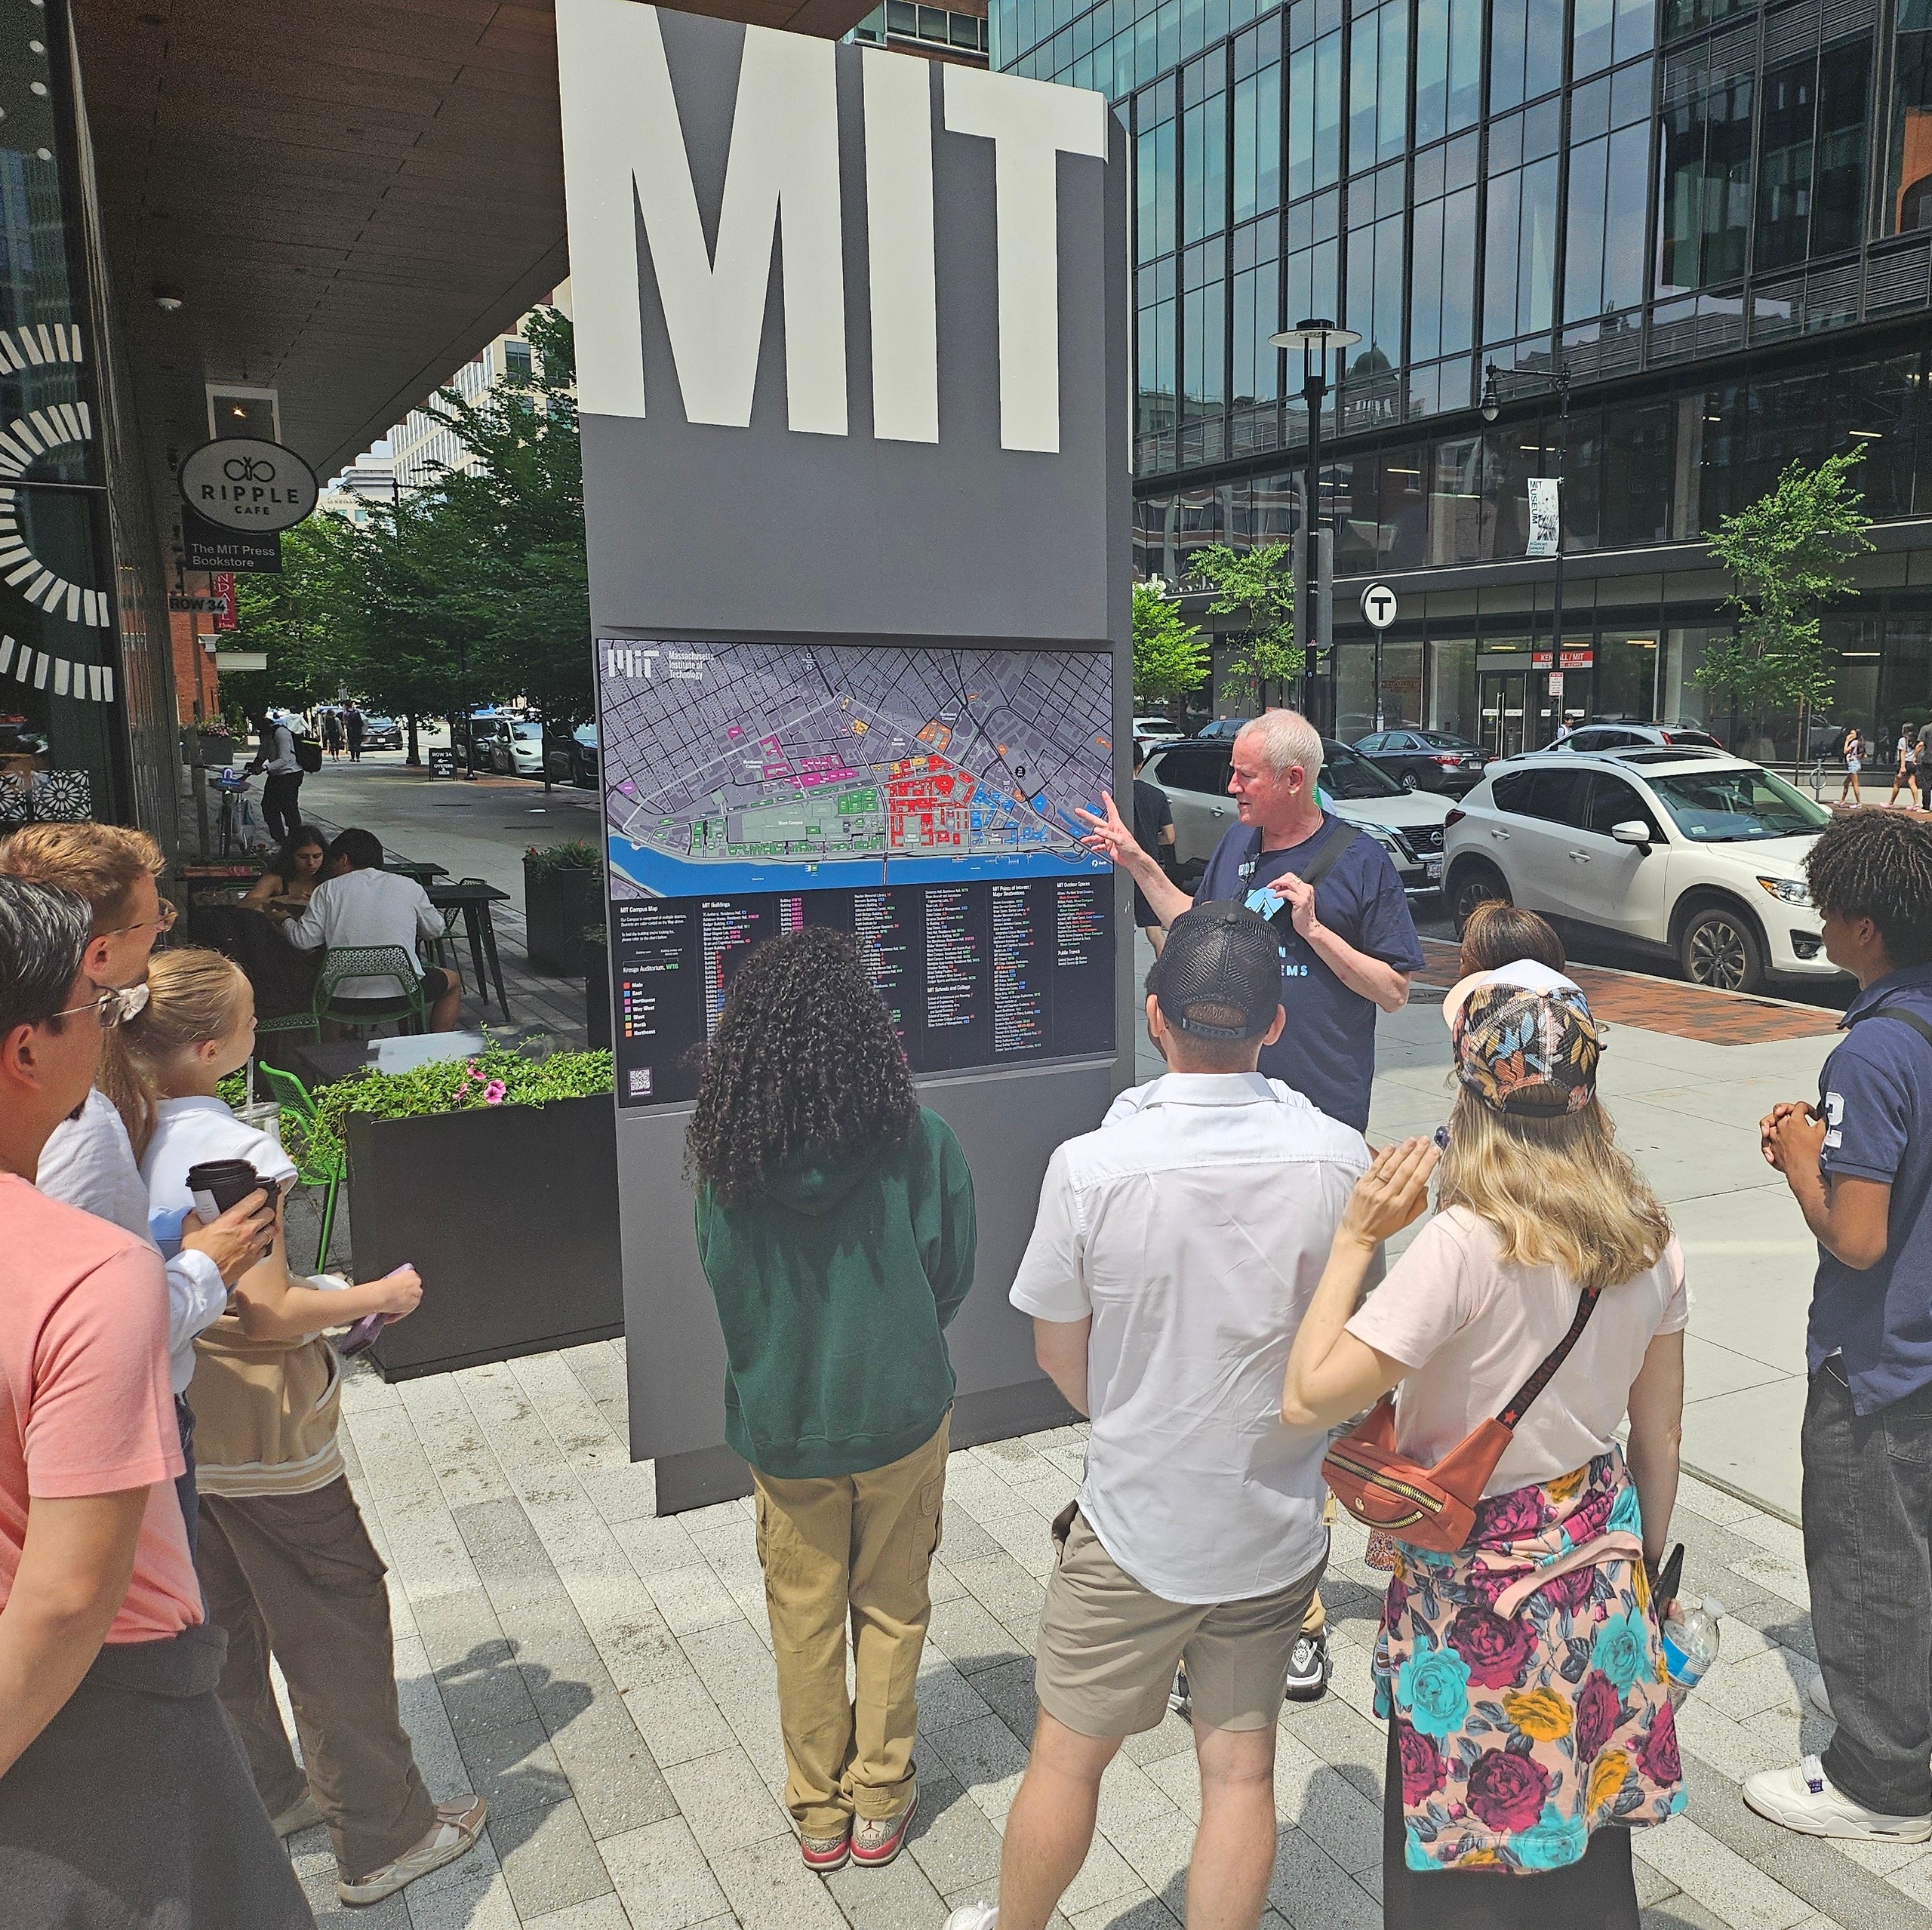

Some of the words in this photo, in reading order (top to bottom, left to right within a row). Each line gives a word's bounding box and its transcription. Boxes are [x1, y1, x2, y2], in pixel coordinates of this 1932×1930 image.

[556, 0, 1106, 453] MIT
[201, 484, 300, 504] RIPPLE
[234, 505, 270, 516] CAFE
[192, 543, 214, 554] The
[217, 543, 240, 555] MIT
[242, 545, 275, 556] Press
[192, 556, 254, 568] Bookstore
[171, 598, 205, 610] ROW
[208, 599, 226, 611] 34
[1371, 597, 1392, 620] T
[668, 651, 715, 661] Massachusetts
[669, 660, 696, 669] Institute
[696, 660, 703, 669] of
[669, 669, 703, 681] Technology
[639, 964, 666, 972] Auditorium,
